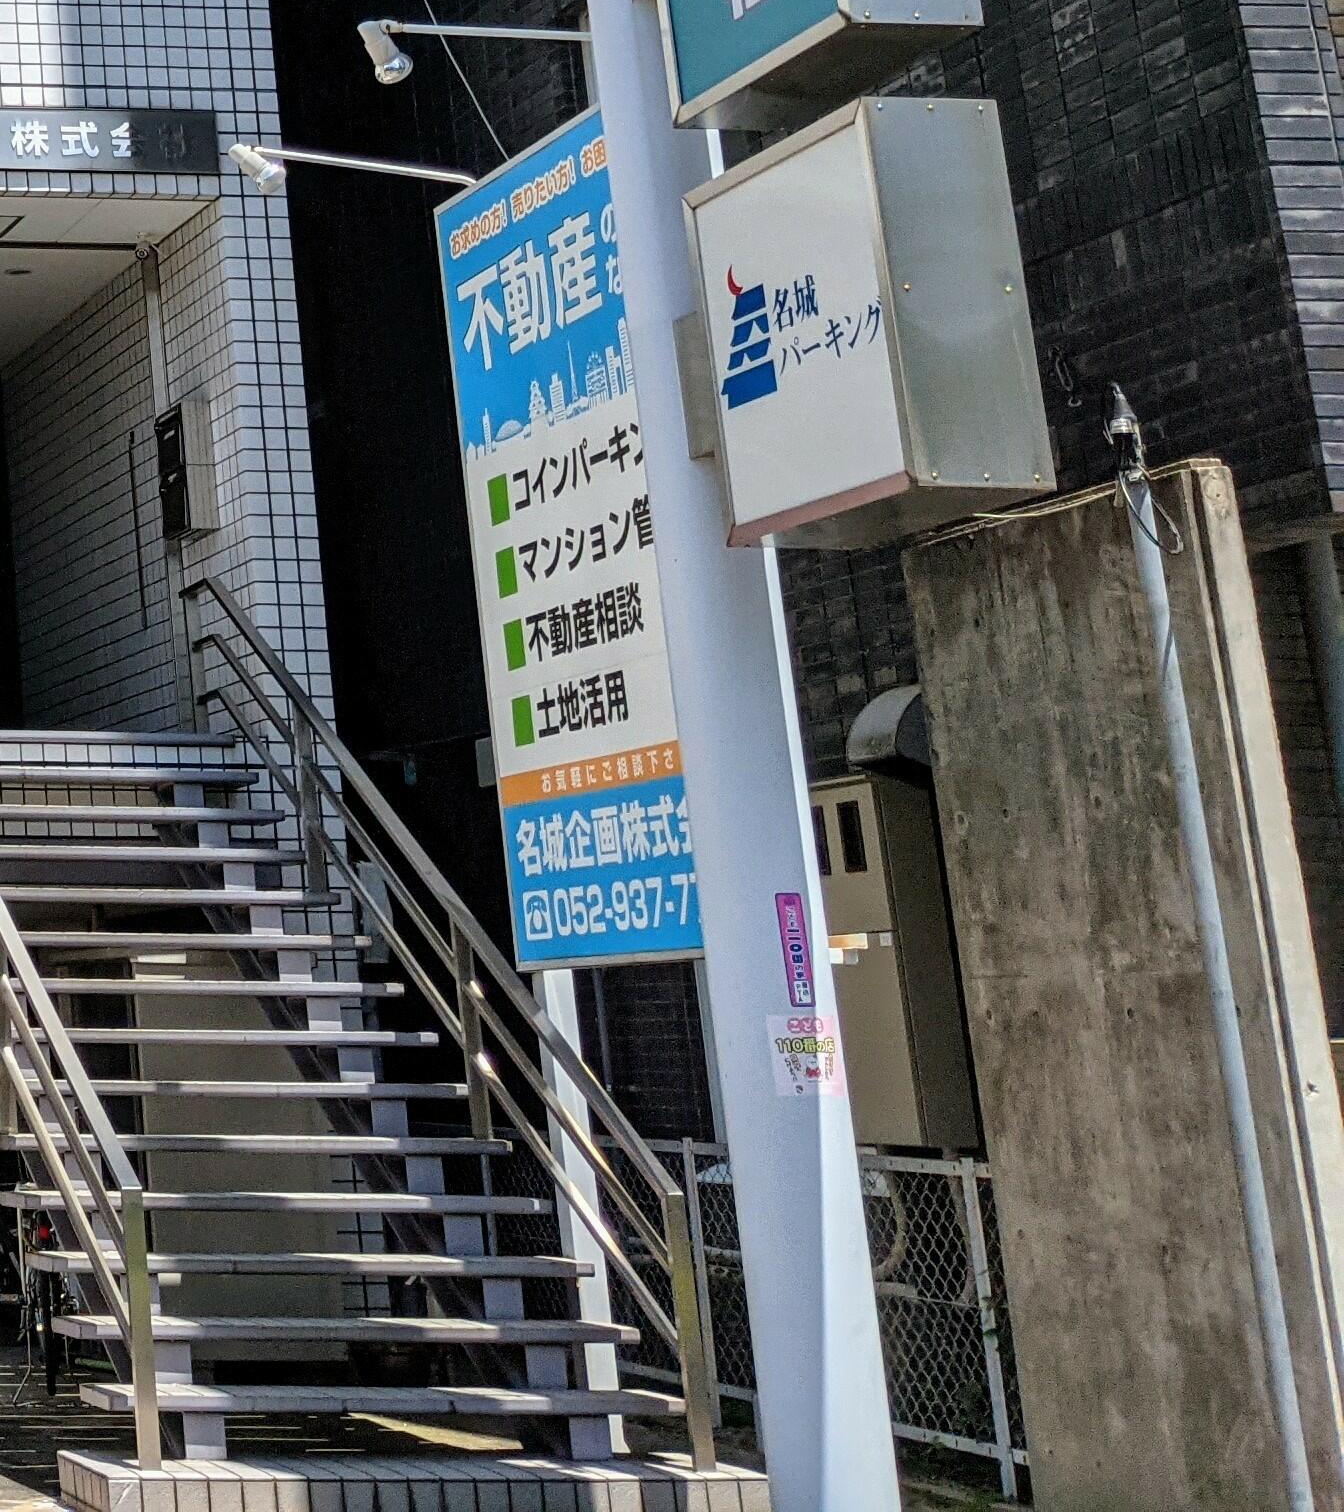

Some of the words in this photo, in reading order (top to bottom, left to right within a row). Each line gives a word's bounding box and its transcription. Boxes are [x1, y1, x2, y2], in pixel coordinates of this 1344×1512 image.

[457, 212, 603, 370] 不動産
[773, 274, 819, 332] 名城
[780, 296, 882, 376] パーキング
[518, 494, 654, 582] マンション管
[525, 582, 644, 662] 不動産相談
[536, 670, 629, 738] 土地活用
[541, 748, 675, 793] お気軽にご相談下さ
[553, 872, 697, 936] 052-937-7
